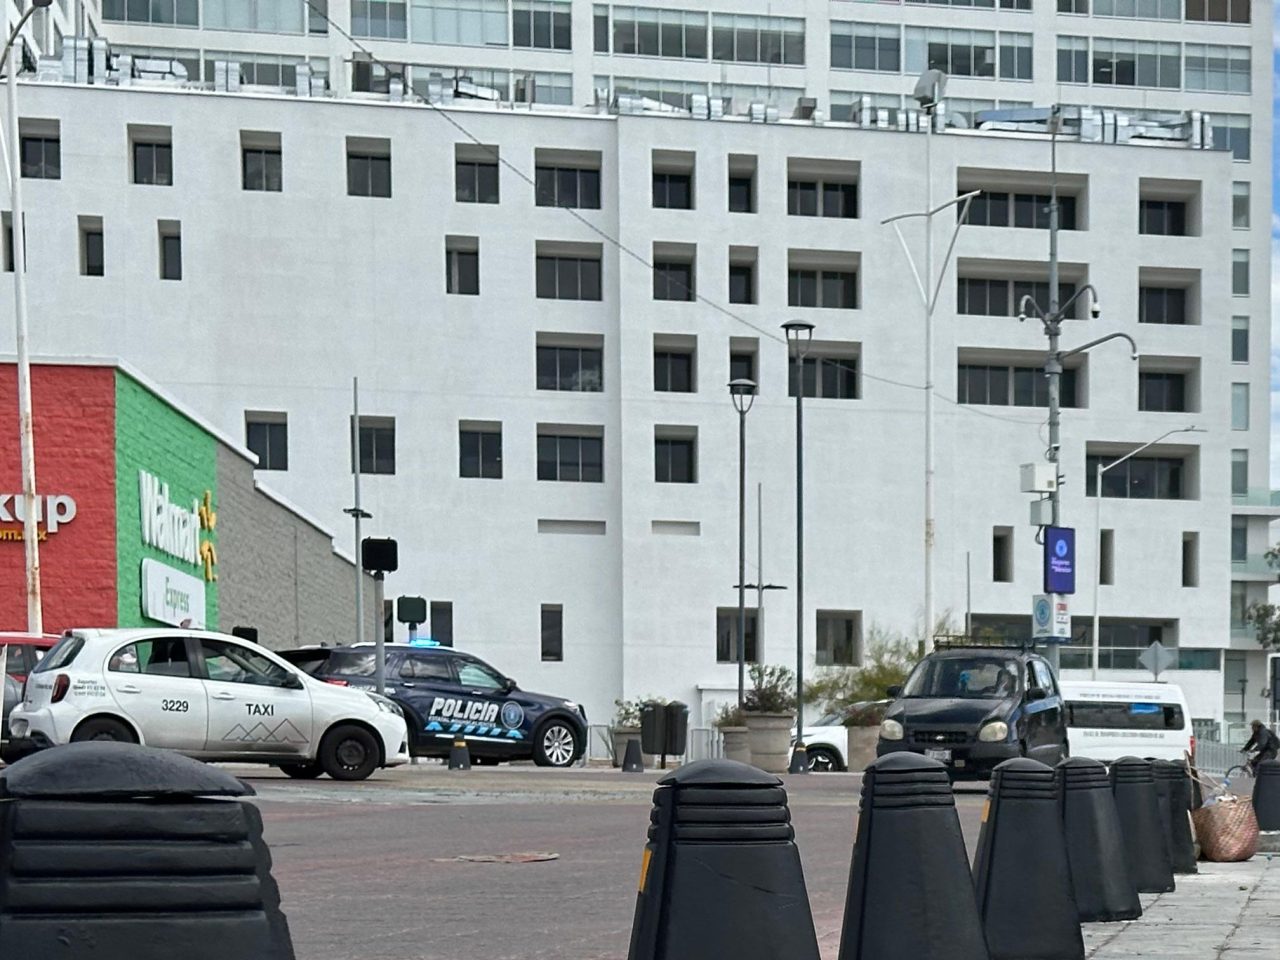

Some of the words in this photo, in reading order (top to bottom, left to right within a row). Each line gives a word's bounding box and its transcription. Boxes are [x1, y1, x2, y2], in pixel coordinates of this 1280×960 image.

[138, 469, 202, 566] Walmart
[165, 576, 190, 617] Express
[161, 699, 189, 713] 3229
[245, 703, 274, 716] TAXI
[429, 696, 499, 723] POLICÍA
